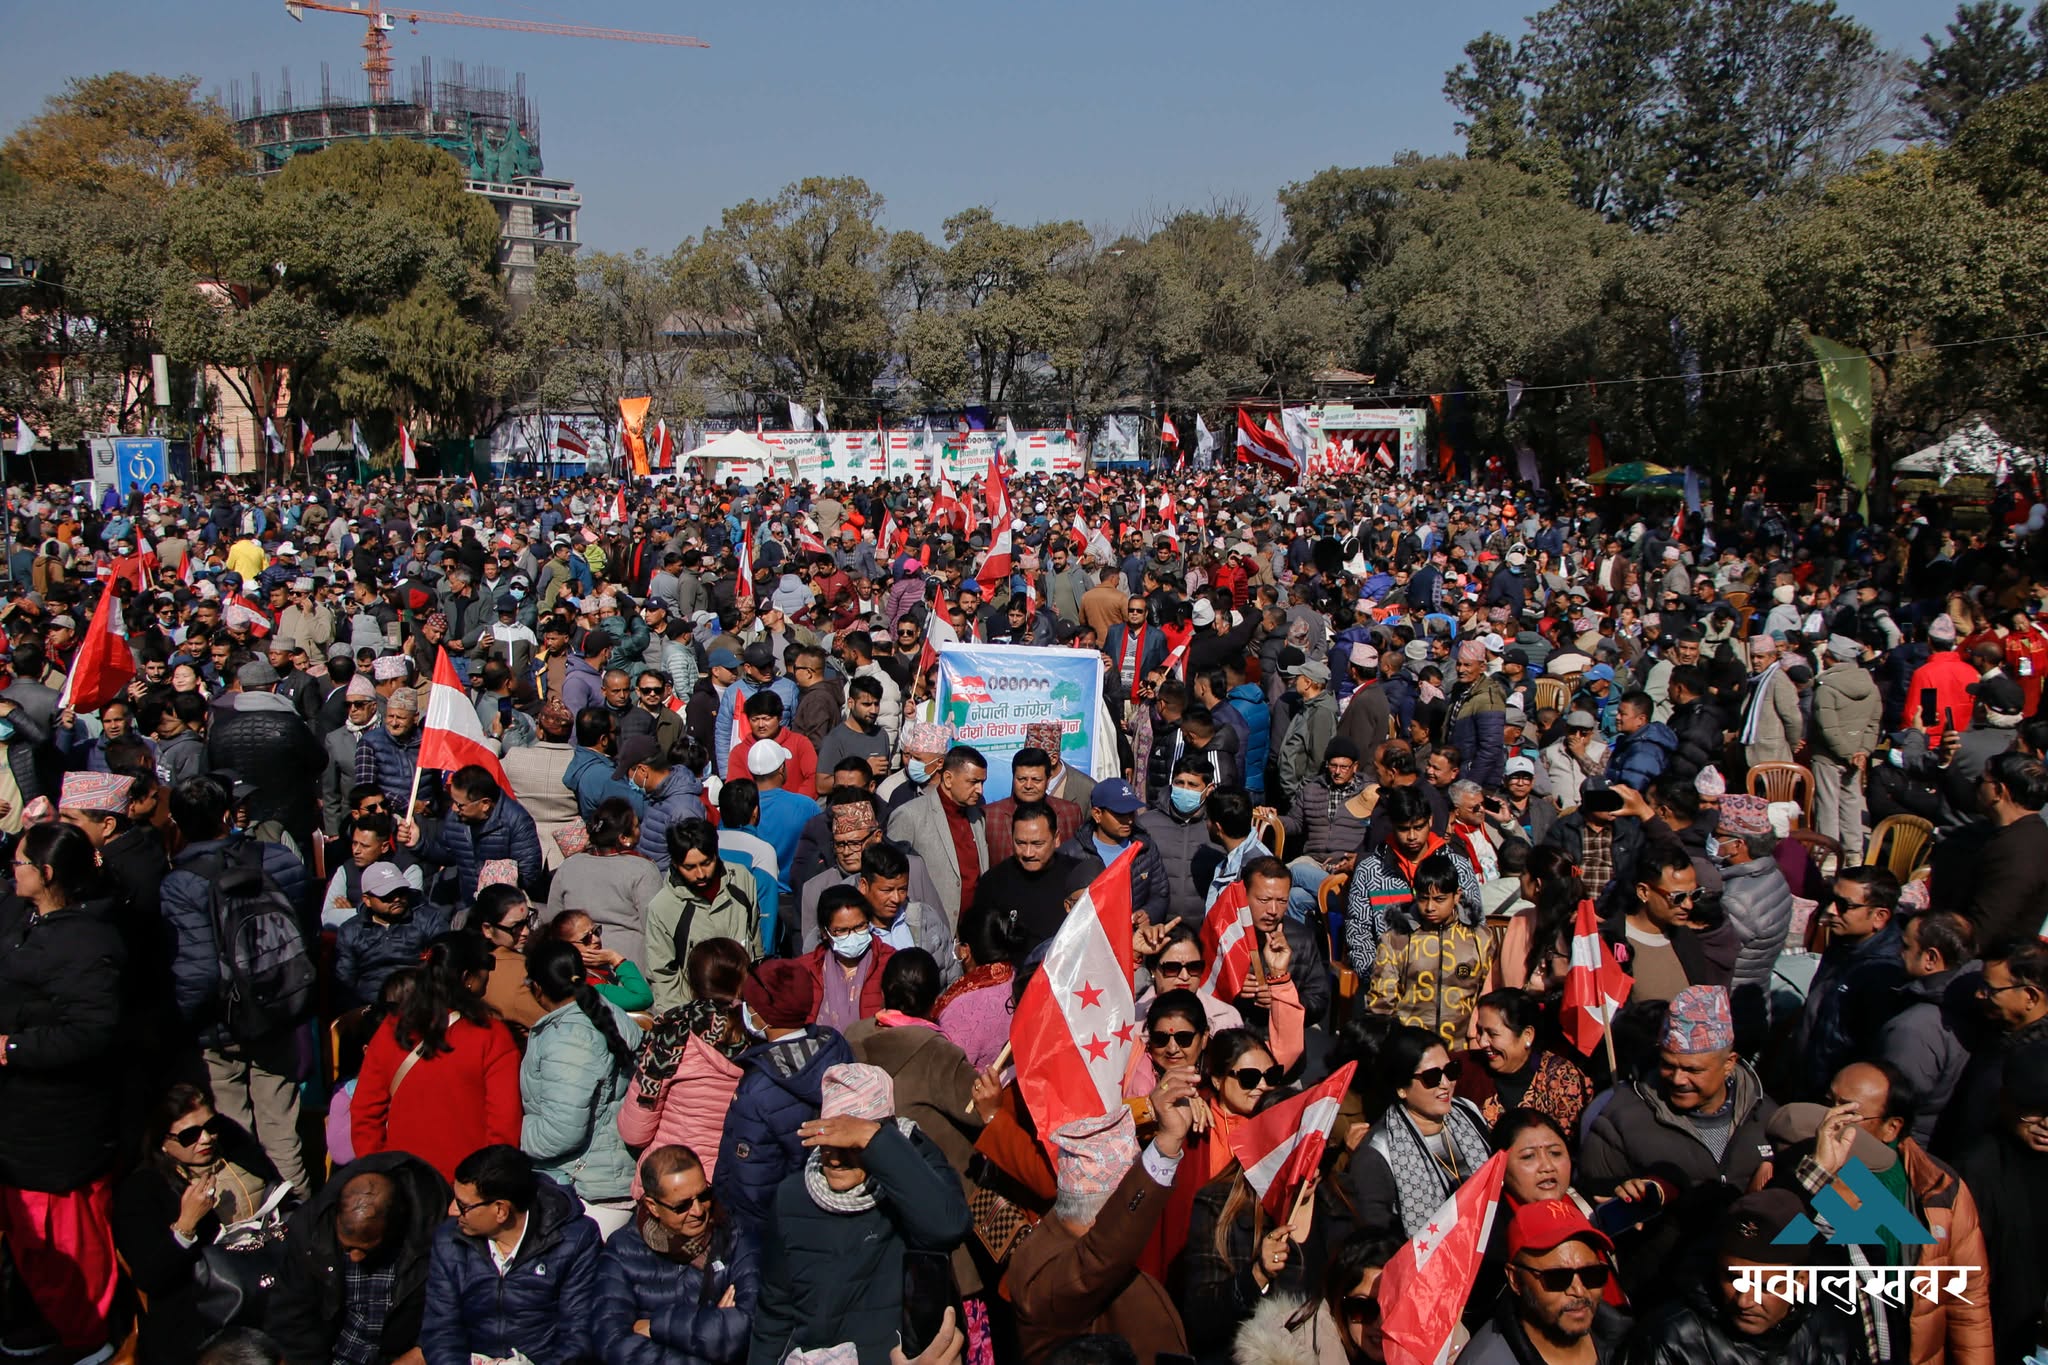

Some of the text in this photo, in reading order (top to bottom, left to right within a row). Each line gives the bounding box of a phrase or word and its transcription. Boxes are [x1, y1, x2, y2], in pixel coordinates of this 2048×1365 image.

[972, 700, 1053, 721] नेपाली कांग्रेस
[986, 722, 1018, 738] विशेष
